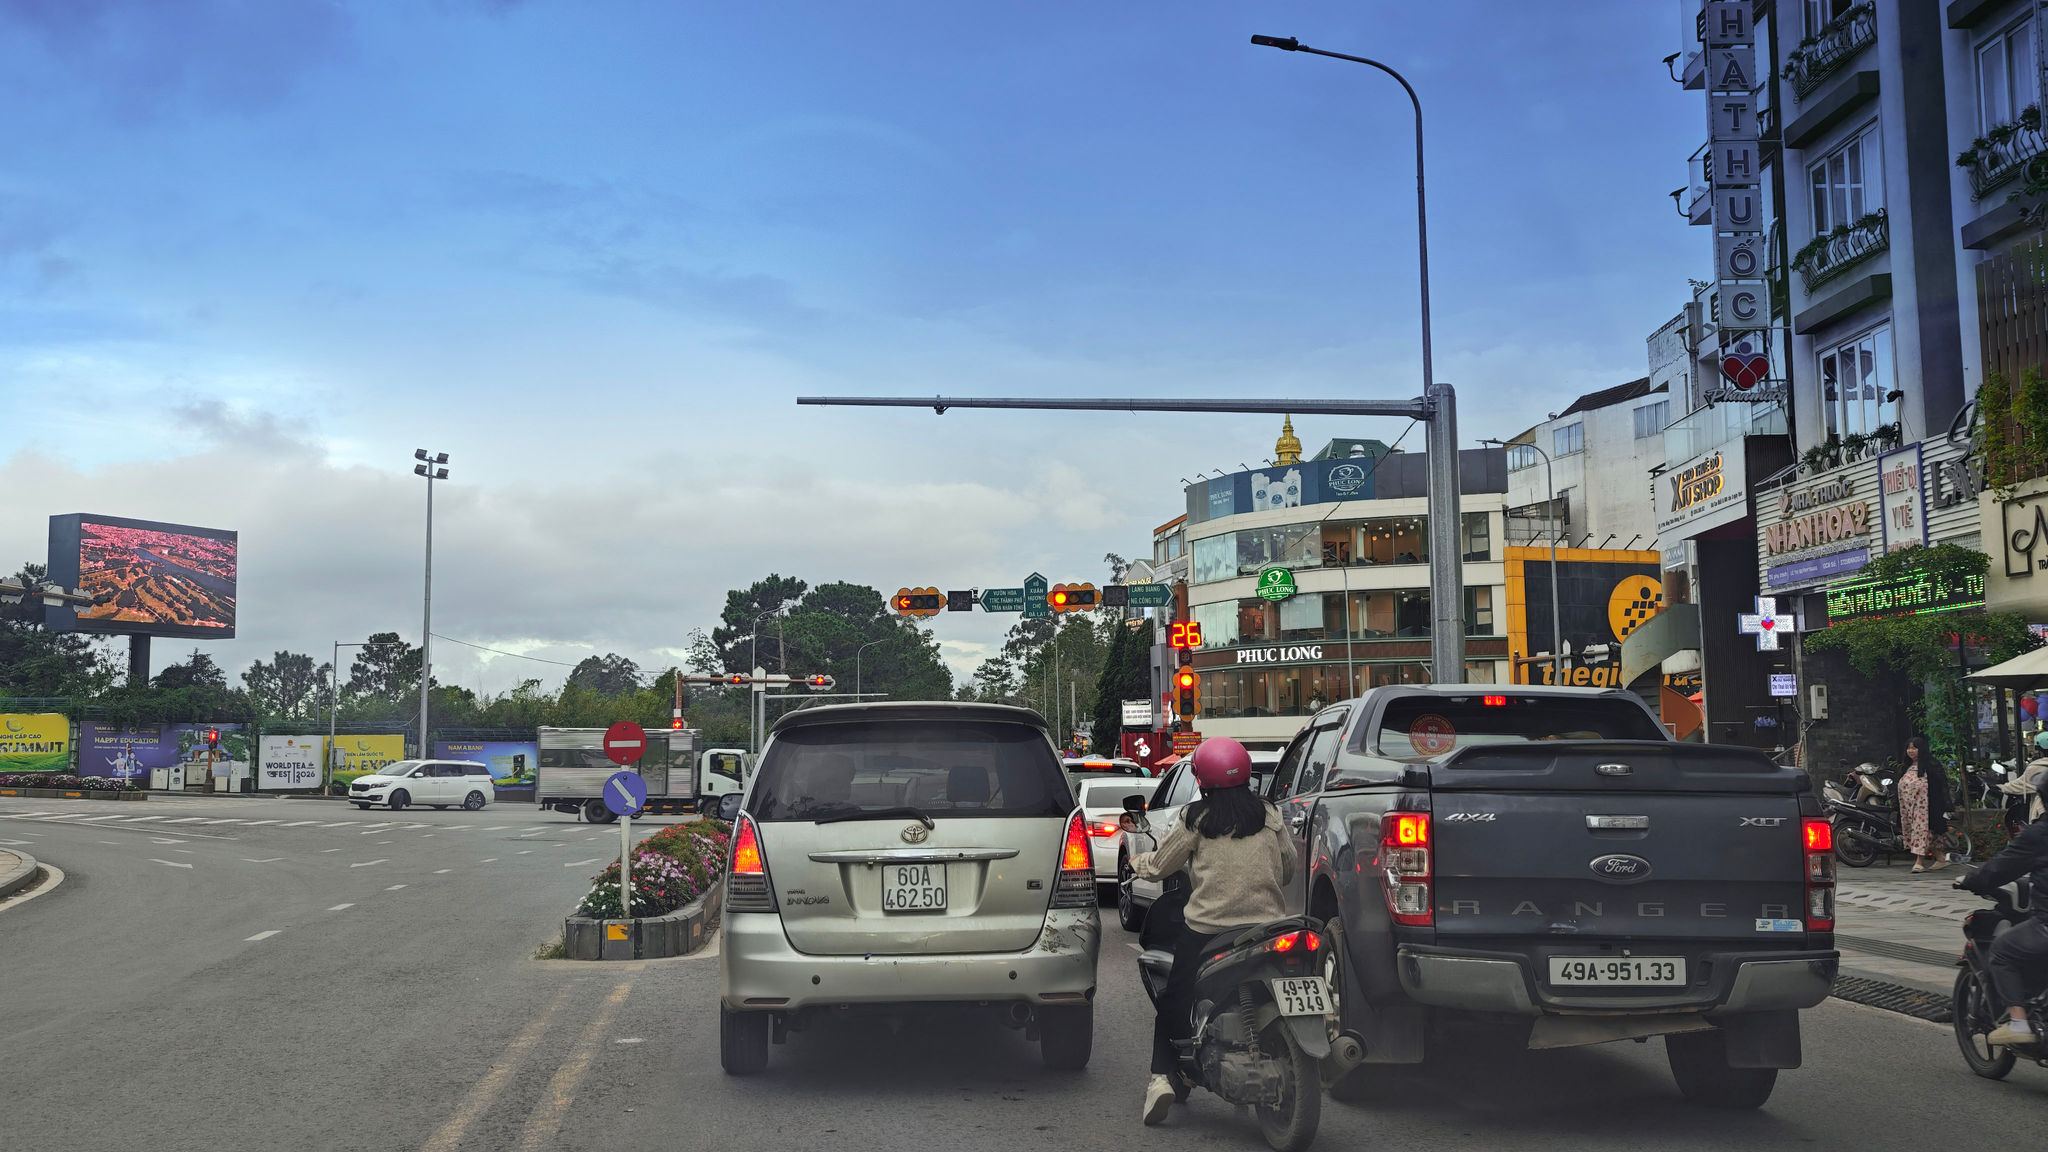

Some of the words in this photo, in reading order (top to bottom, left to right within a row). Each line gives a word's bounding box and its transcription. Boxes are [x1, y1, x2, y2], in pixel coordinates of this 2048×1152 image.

[1706, 388, 1788, 408] Pharmacy
[1693, 475, 1721, 502] SHOP
[1172, 622, 1200, 647] 26
[1236, 648, 1277, 663] PHUC
[1280, 646, 1323, 661] LONG
[0, 742, 64, 753] SUMMIT
[94, 736, 118, 744] HAPPY
[292, 762, 306, 770] TEA
[1444, 813, 1496, 822] 4X4
[1739, 816, 1787, 827] XLT
[1604, 858, 1637, 874] Ford
[898, 866, 931, 886] 60A
[786, 895, 830, 905] INNOVA
[885, 887, 945, 908] 462.50
[1452, 900, 1789, 919] RANGER
[1561, 962, 1675, 981] 49A-951.33
[1282, 979, 1320, 996] 49-P3
[1285, 996, 1325, 1013] 7349
